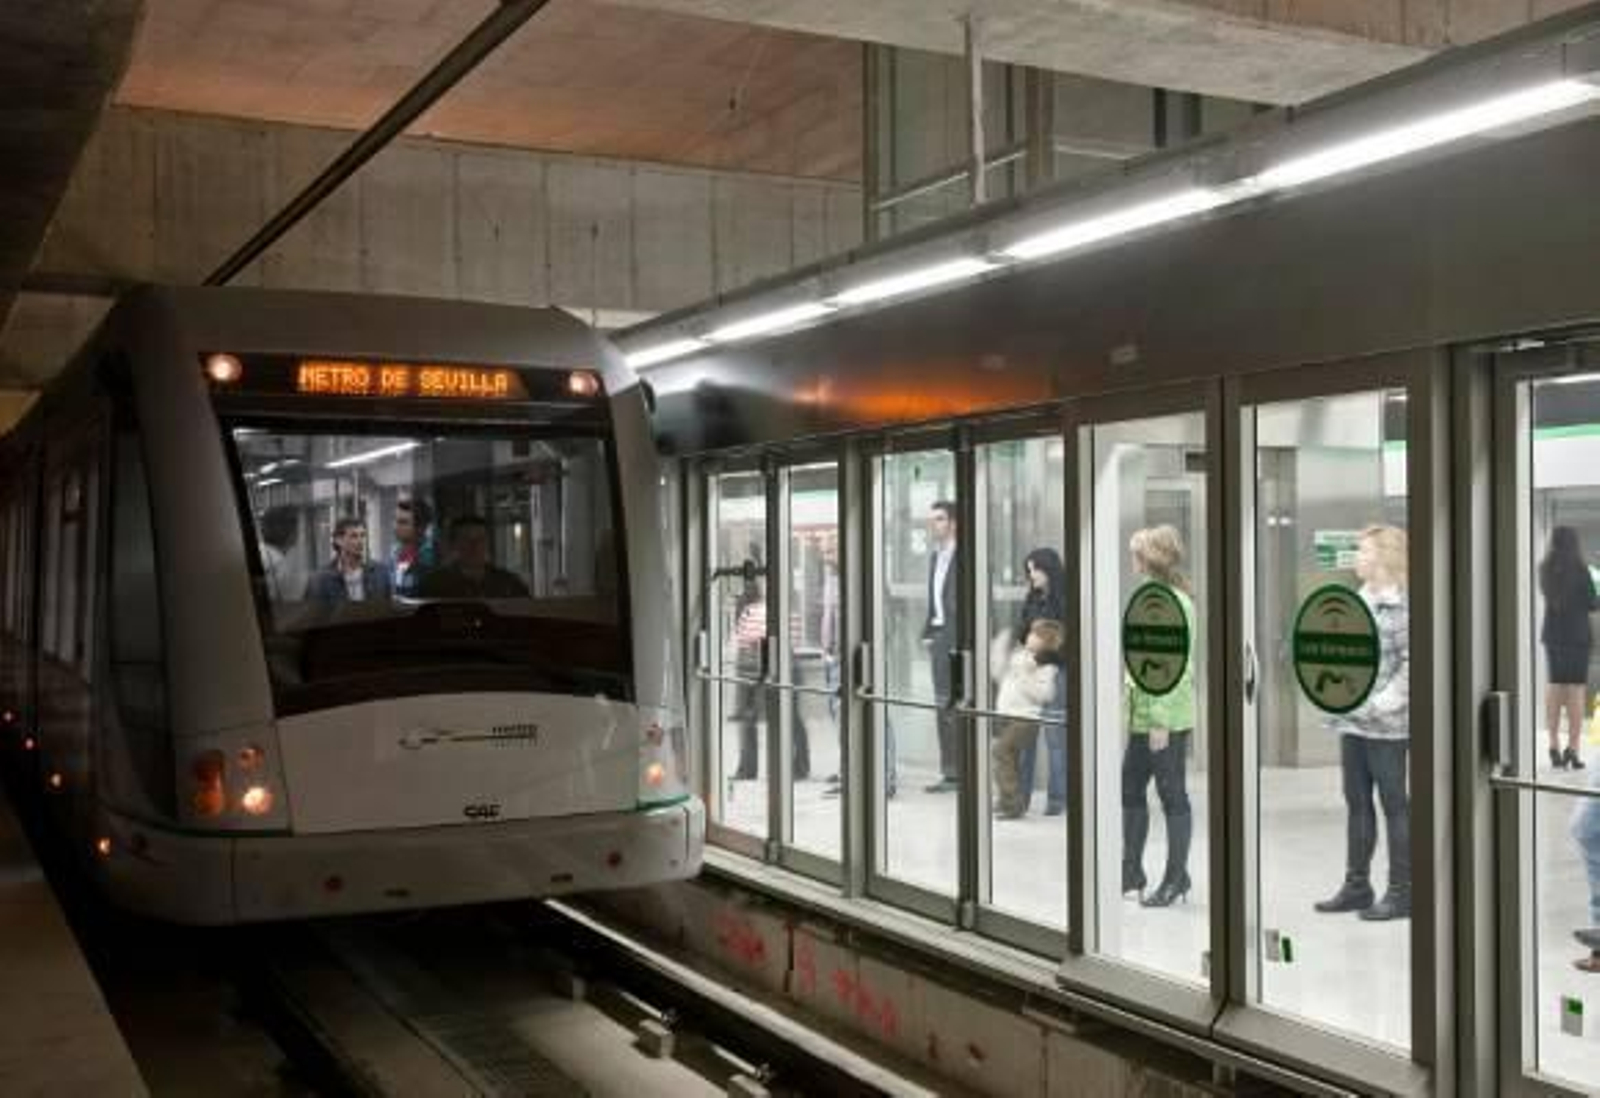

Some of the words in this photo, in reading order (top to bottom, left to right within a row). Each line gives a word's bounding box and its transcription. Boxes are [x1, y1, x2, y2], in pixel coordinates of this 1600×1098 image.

[299, 362, 370, 391] METRO
[381, 365, 409, 392] DE
[419, 367, 509, 393] SEVILLA
